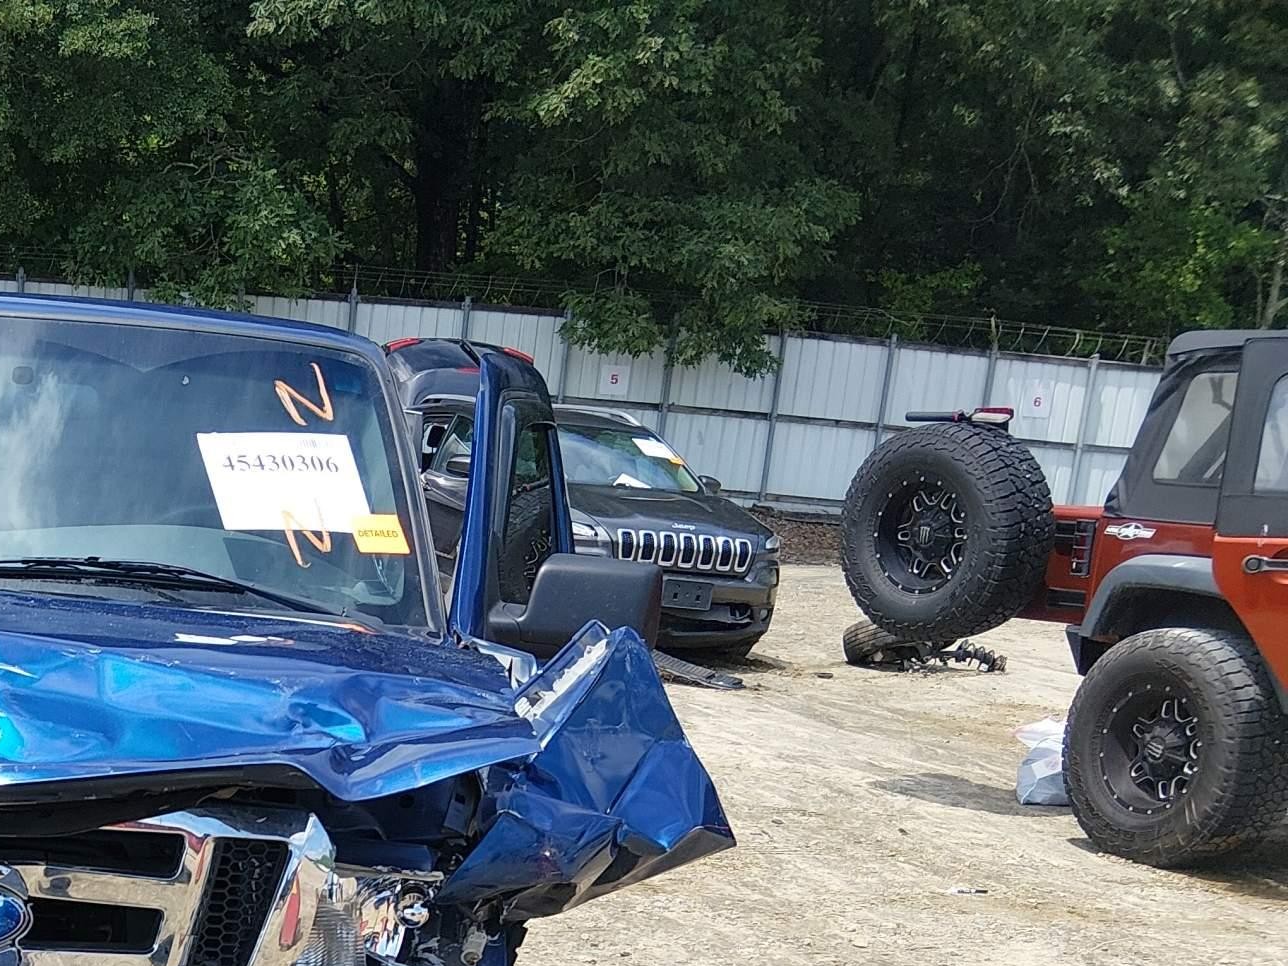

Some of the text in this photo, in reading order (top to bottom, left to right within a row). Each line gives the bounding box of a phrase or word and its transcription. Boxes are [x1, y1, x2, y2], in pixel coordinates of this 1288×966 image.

[610, 374, 619, 385] 5
[274, 362, 334, 426] N
[1033, 397, 1042, 407] 6
[223, 455, 339, 473] 45430306
[358, 529, 399, 539] DETAILED
